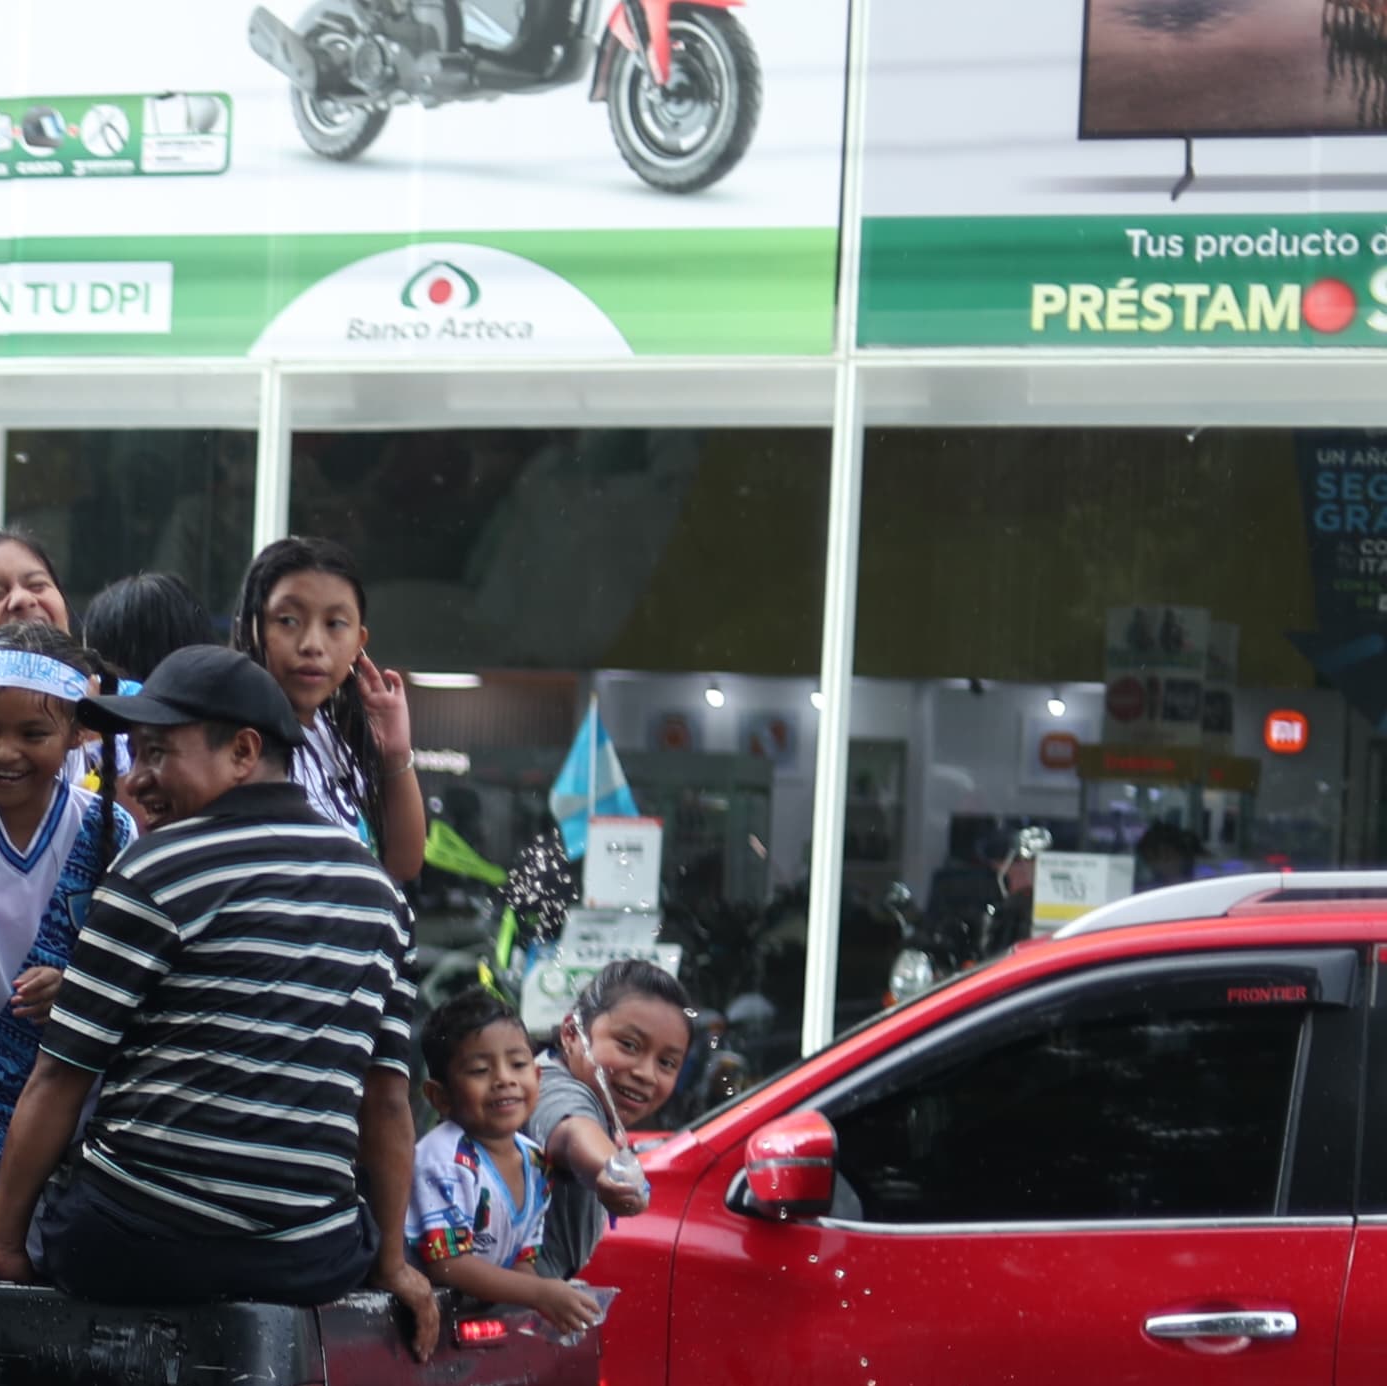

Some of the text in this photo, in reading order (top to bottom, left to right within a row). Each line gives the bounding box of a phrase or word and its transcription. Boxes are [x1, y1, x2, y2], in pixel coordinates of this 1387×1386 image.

[1125, 228, 1184, 258] Tus
[1195, 227, 1359, 263] producto
[24, 283, 75, 315] TU
[89, 281, 150, 315] DPI
[346, 317, 534, 342] Banco Azteca
[1227, 986, 1307, 1002] FRONTIER
